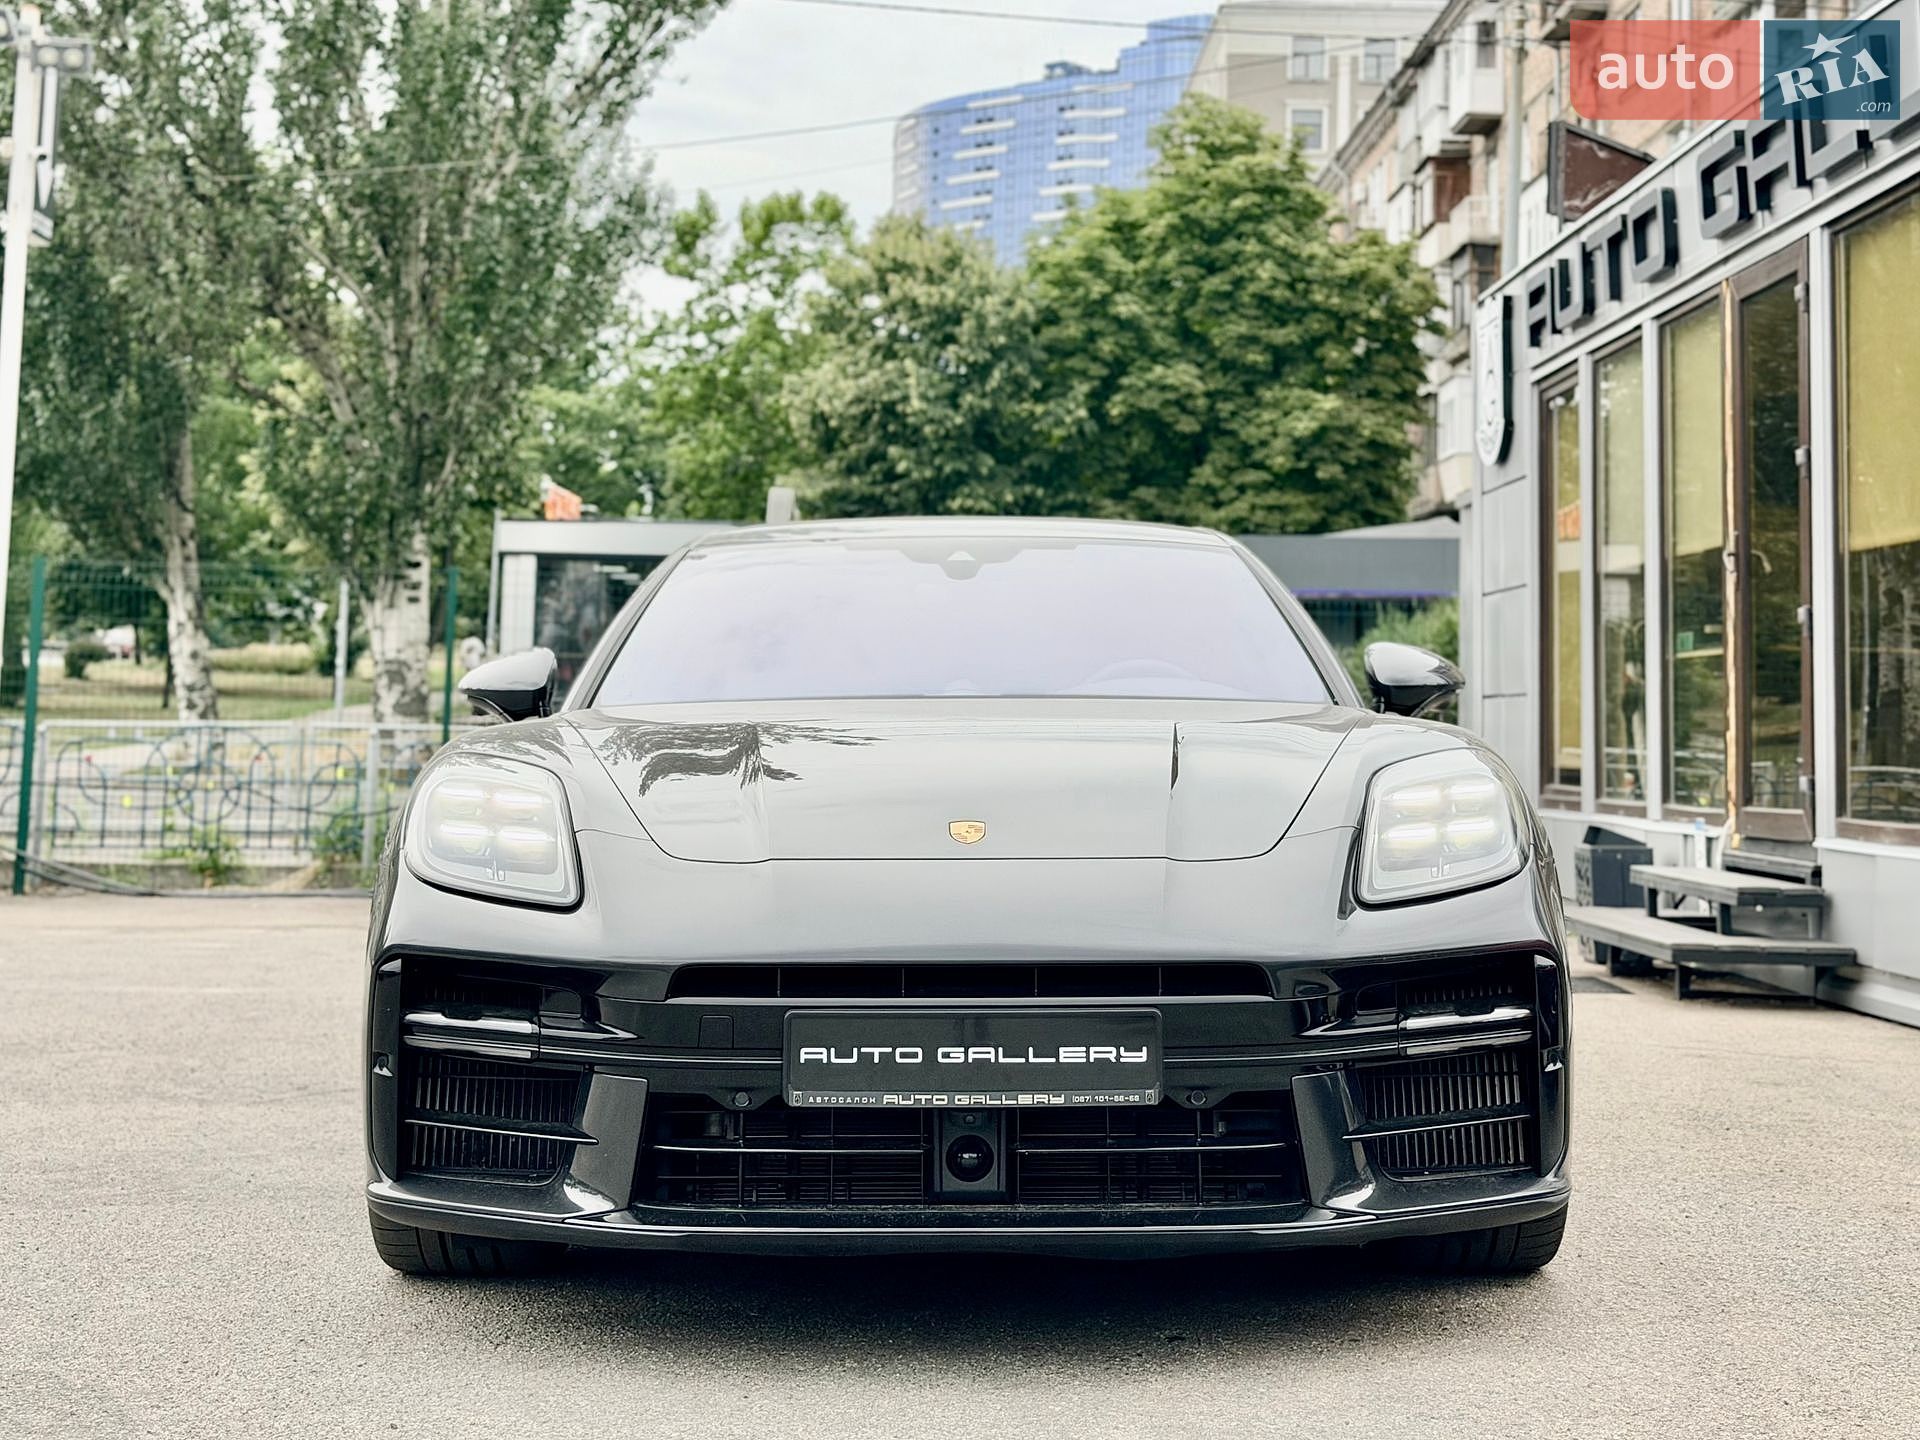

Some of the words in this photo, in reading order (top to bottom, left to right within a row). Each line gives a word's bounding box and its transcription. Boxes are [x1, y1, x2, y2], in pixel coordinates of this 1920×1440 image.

[1525, 187, 1679, 347] AUTO
[799, 1047, 923, 1064] AUTO
[937, 1046, 1148, 1063] GALLERY
[883, 1094, 948, 1105] AUTO
[954, 1093, 1065, 1105] GALLERY
